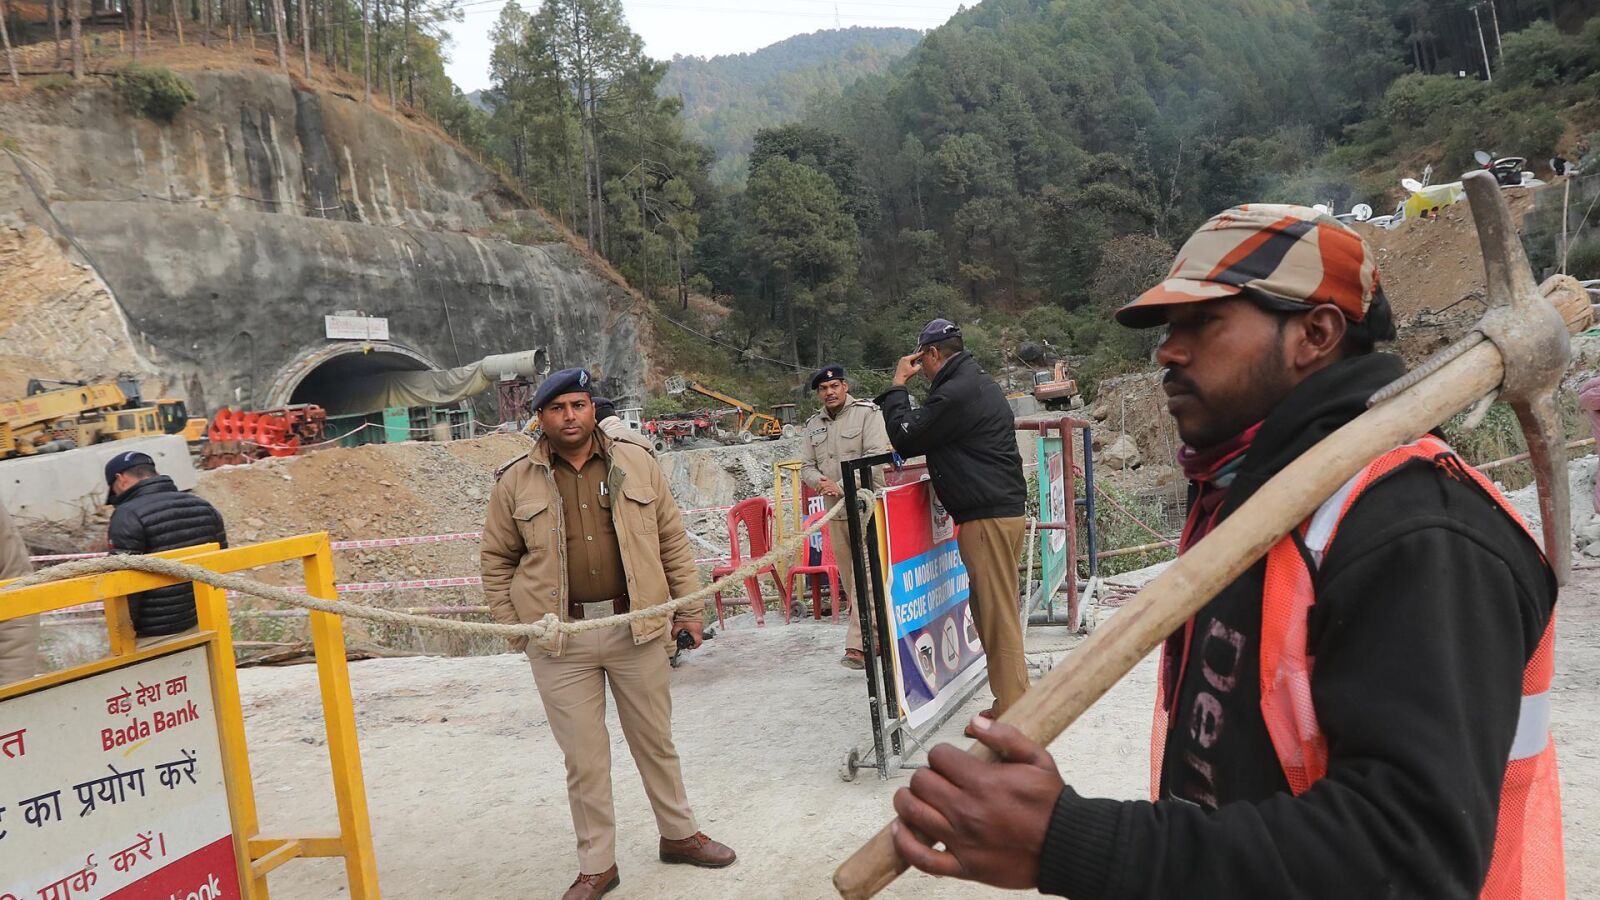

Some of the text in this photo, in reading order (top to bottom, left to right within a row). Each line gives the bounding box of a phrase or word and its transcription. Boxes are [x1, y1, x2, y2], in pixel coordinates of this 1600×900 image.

[902, 569, 915, 593] NO
[915, 557, 938, 588] MOBILE
[895, 595, 927, 627] RESCUE
[106, 675, 188, 717] बड़े देश का
[101, 700, 200, 751] Bada Bank
[18, 790, 62, 828] का
[72, 764, 146, 818] प्रयोग
[154, 749, 198, 790] करें
